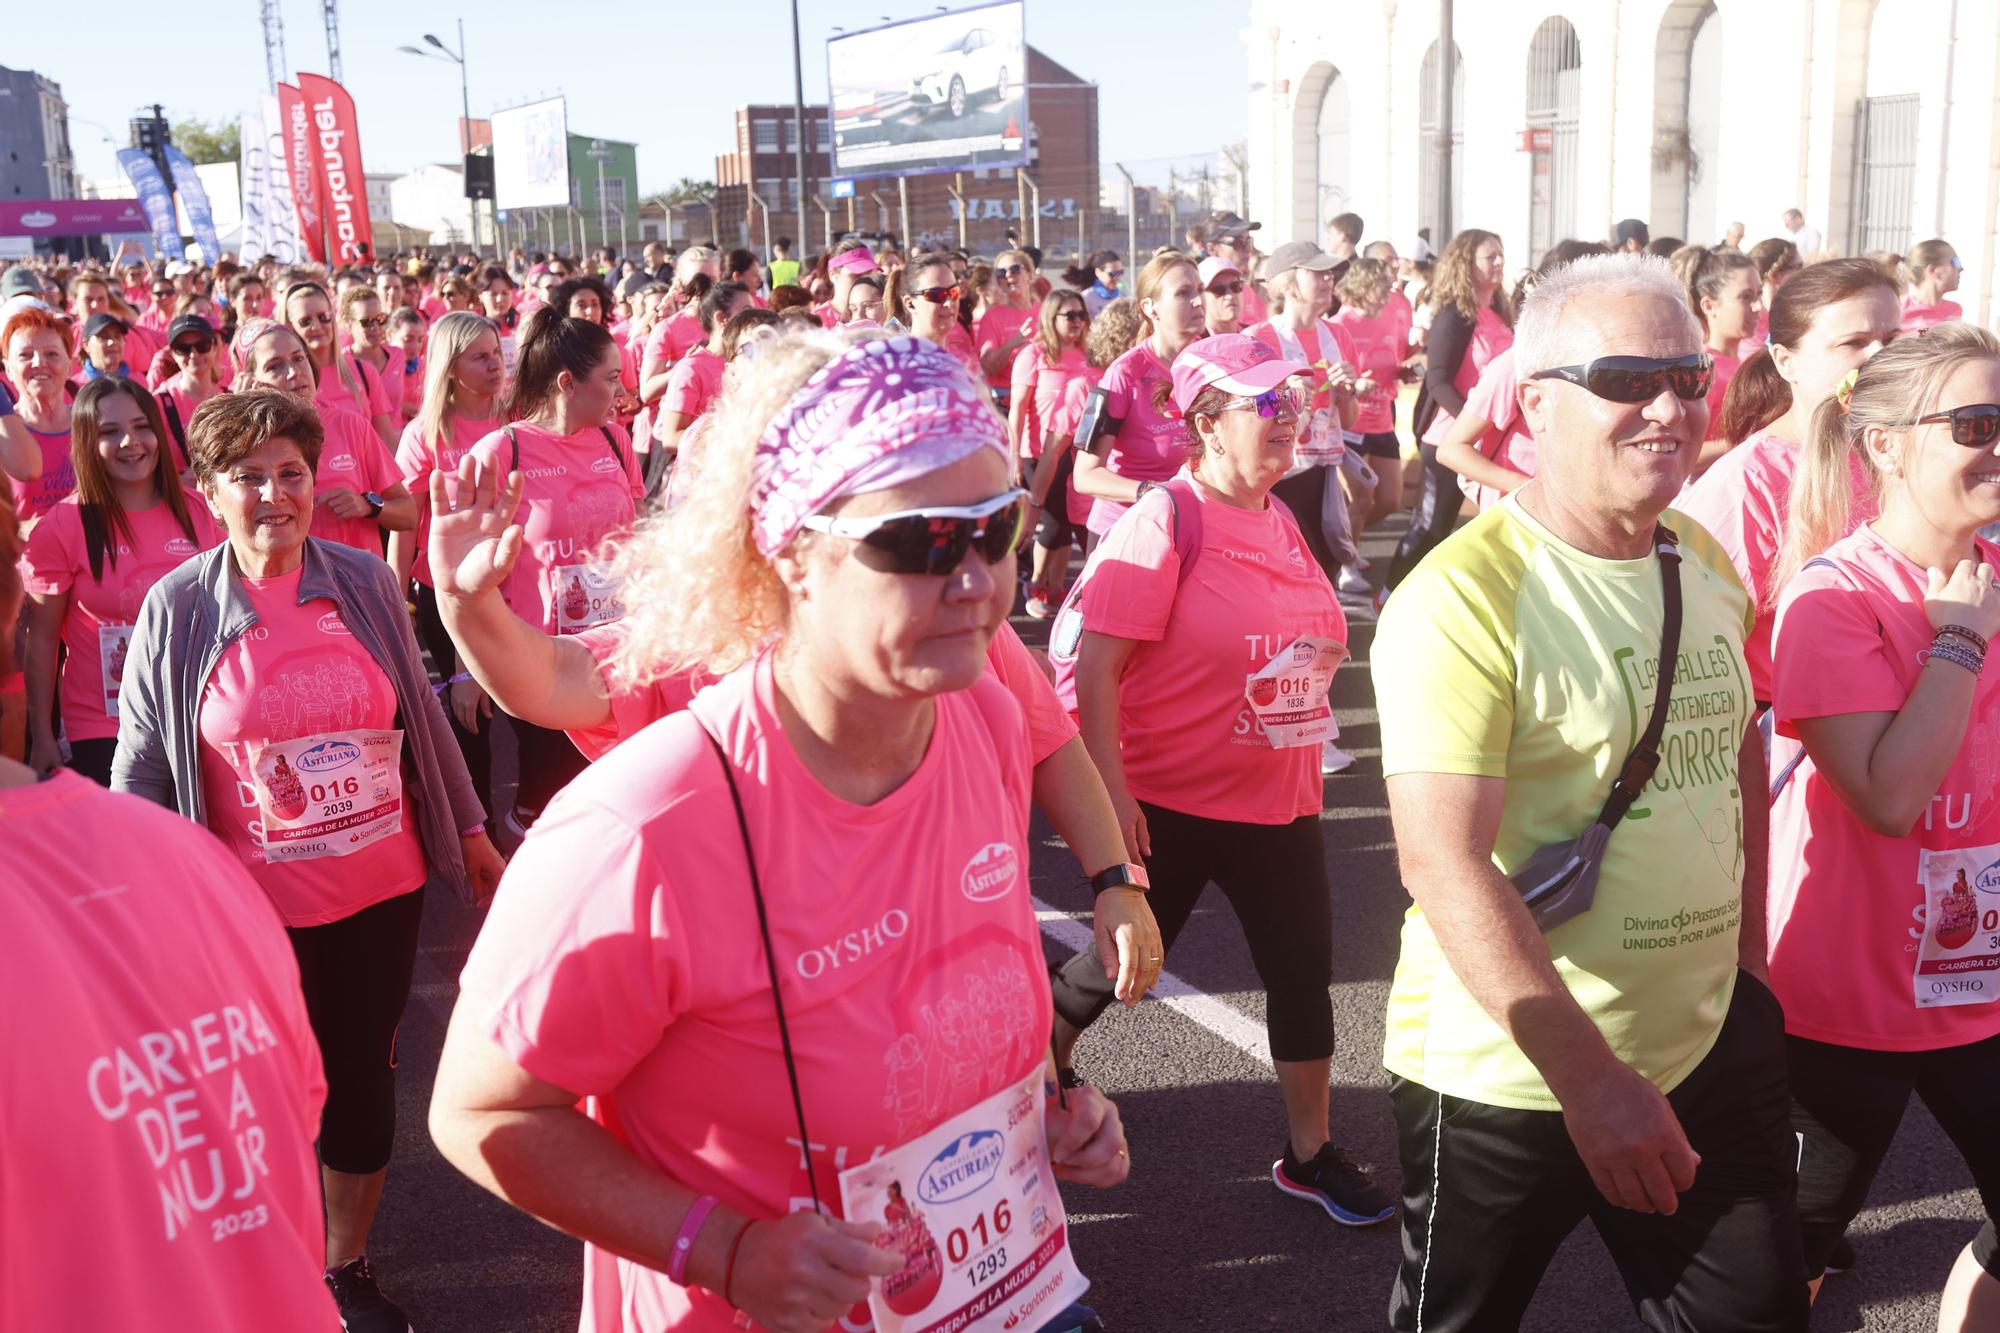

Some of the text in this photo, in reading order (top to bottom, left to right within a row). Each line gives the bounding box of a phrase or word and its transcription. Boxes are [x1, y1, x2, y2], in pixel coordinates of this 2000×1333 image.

[526, 465, 567, 480] OYSHO
[543, 537, 574, 563] TU
[1245, 634, 1282, 660] TU
[1280, 677, 1310, 695] 016
[1286, 697, 1305, 708] 1836
[302, 750, 356, 768] ASTURIANA
[310, 776, 359, 803] 016
[323, 799, 353, 817] 2039
[283, 825, 324, 839] CARRERA
[325, 822, 337, 832] DE
[338, 820, 349, 830] LA
[350, 811, 375, 825] MUJER
[360, 819, 393, 840] Santander
[280, 842, 327, 855] OYSHO
[1624, 916, 1669, 931] Divina
[1692, 904, 1727, 924] Pastora
[796, 908, 909, 979] OYSHO
[1623, 936, 1677, 950] UNIDOS
[1680, 930, 1703, 944] POR
[1706, 923, 1725, 938] UNA
[1938, 958, 1984, 971] CARRERA
[1931, 979, 1984, 994] OYSHO
[87, 996, 279, 1121] CARERA
[135, 1088, 206, 1170] DE
[211, 1203, 270, 1243] 2023
[946, 1198, 1012, 1264] 016
[966, 1246, 1008, 1288] 1293
[969, 1301, 986, 1318] DE
[988, 1287, 1003, 1306] LA
[1004, 1260, 1036, 1297] MUJER
[1019, 1269, 1064, 1320] Santander
